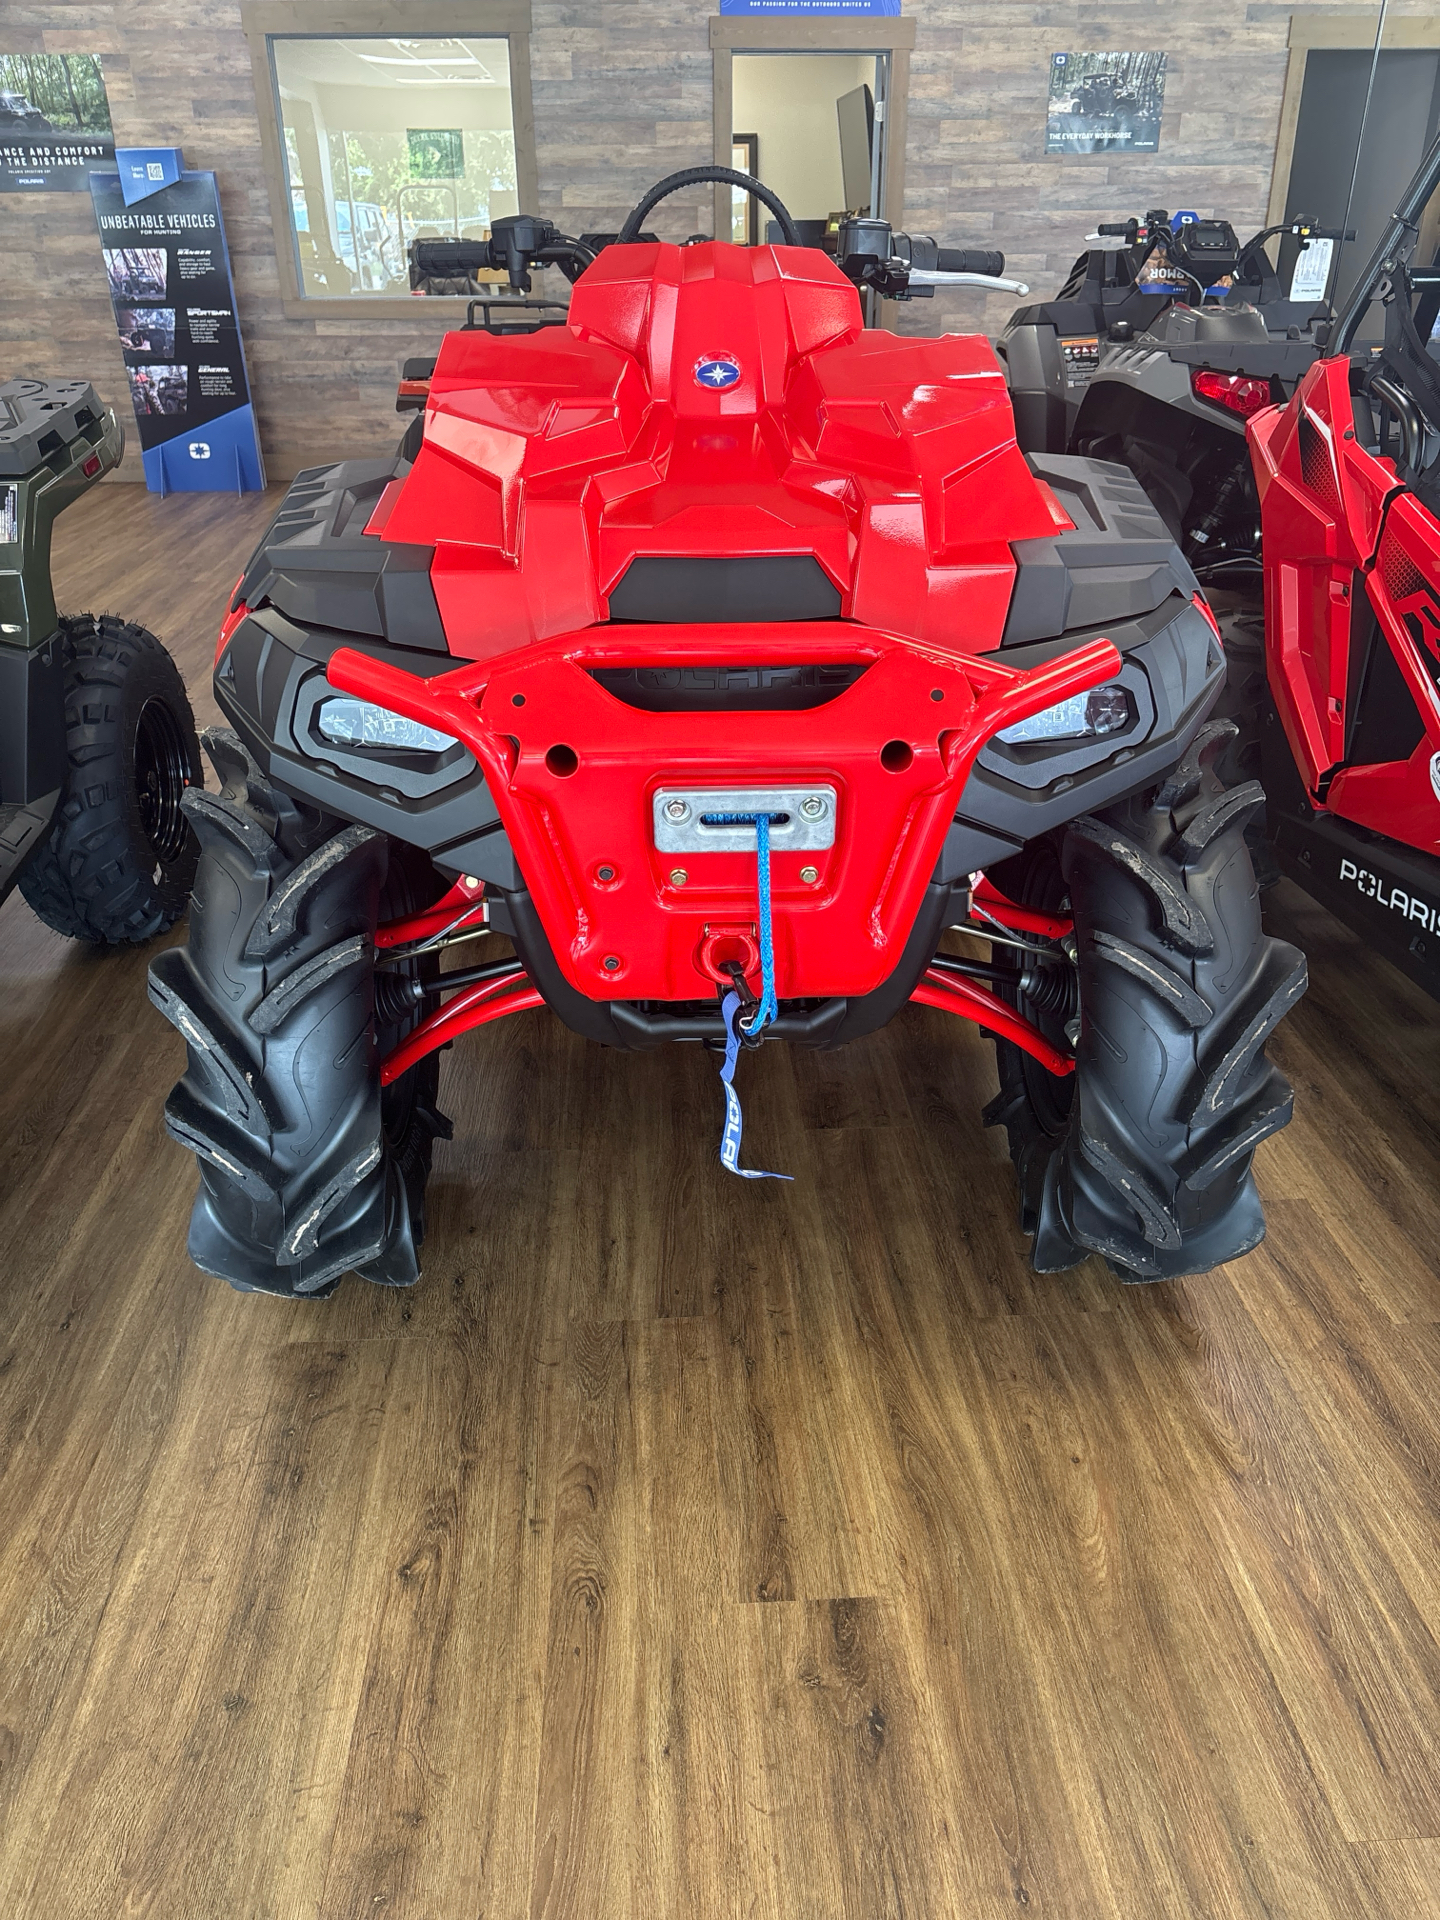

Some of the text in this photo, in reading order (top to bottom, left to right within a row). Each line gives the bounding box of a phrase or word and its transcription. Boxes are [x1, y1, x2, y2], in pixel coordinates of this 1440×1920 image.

[0, 146, 104, 156] ANCE AND COMFORT
[7, 157, 28, 166] THE
[31, 157, 85, 166] DISTANCE
[100, 214, 216, 229] UNBEATABLE VEHICLES
[1339, 858, 1440, 938] POLARI
